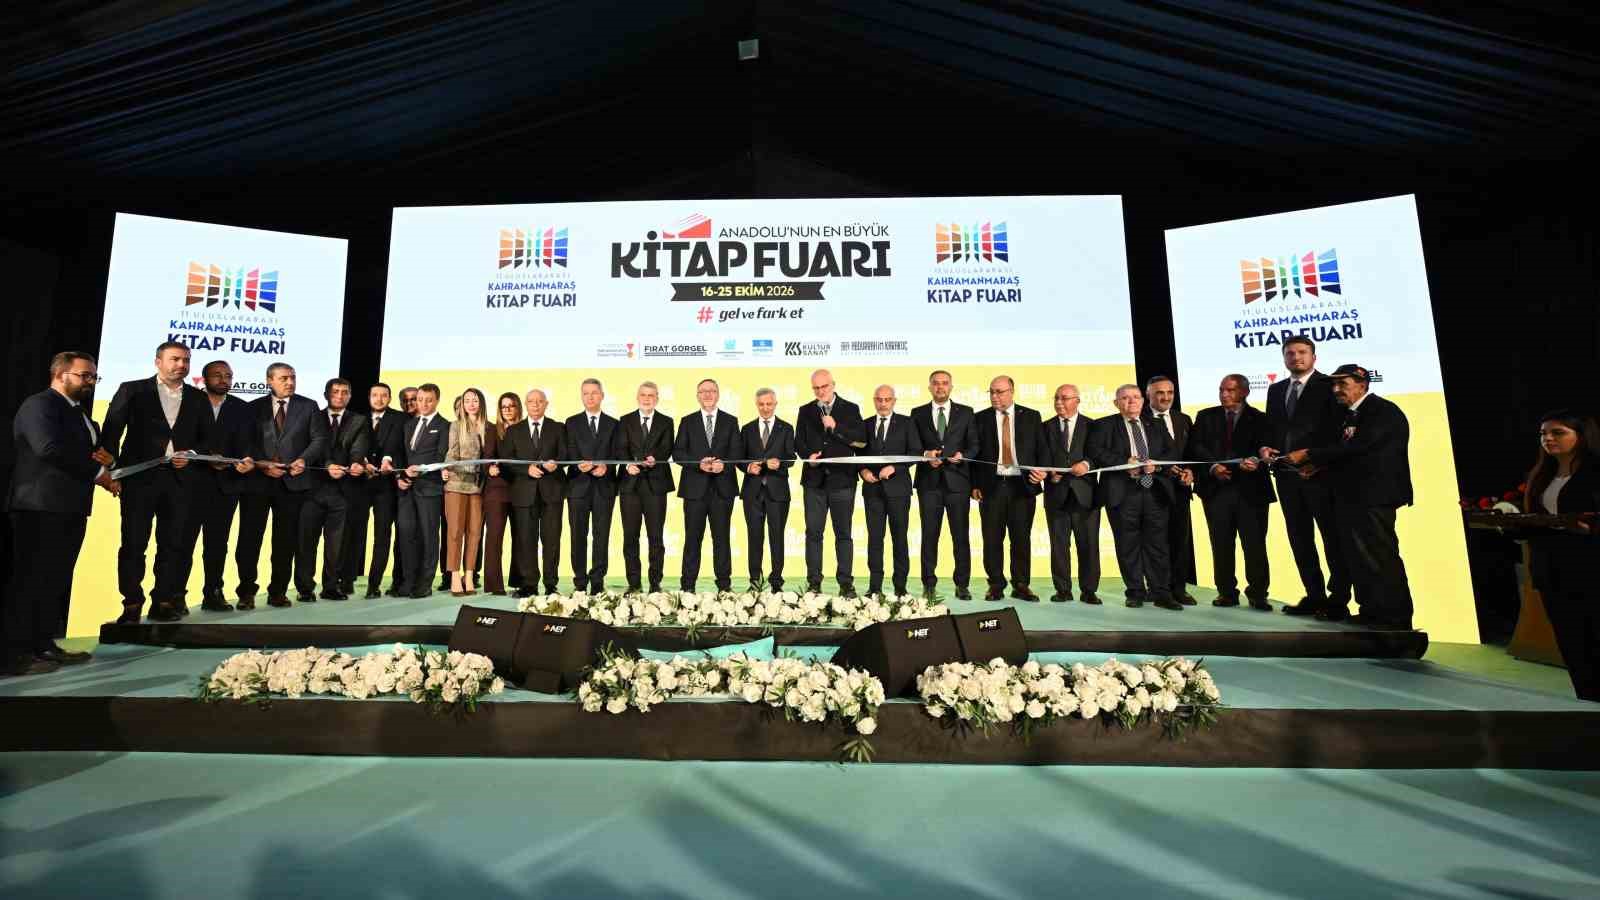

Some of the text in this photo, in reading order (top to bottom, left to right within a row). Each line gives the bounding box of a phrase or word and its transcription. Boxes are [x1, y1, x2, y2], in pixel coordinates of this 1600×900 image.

[718, 222, 889, 238] ANADOLU'NUN EN BÜYÜK
[753, 240, 891, 278] FUARI
[488, 281, 576, 291] KAHRAMANMARAŞ
[928, 276, 1020, 286] KAHRAMANMARAŞ
[701, 283, 795, 297] 16-25 EKİM 2026
[976, 288, 1022, 303] FUARI
[533, 293, 576, 307] FUARI
[718, 307, 741, 323] gel
[742, 311, 755, 319] ve
[756, 307, 788, 319] fark
[789, 307, 804, 319] et
[1234, 309, 1359, 329] KAHRAMANMARAŞ
[169, 320, 286, 338] KAHRAMANMARAŞ
[1300, 323, 1363, 342] FUARI
[230, 337, 286, 355] FUARI
[482, 617, 497, 625] NET
[914, 629, 929, 637] NET
